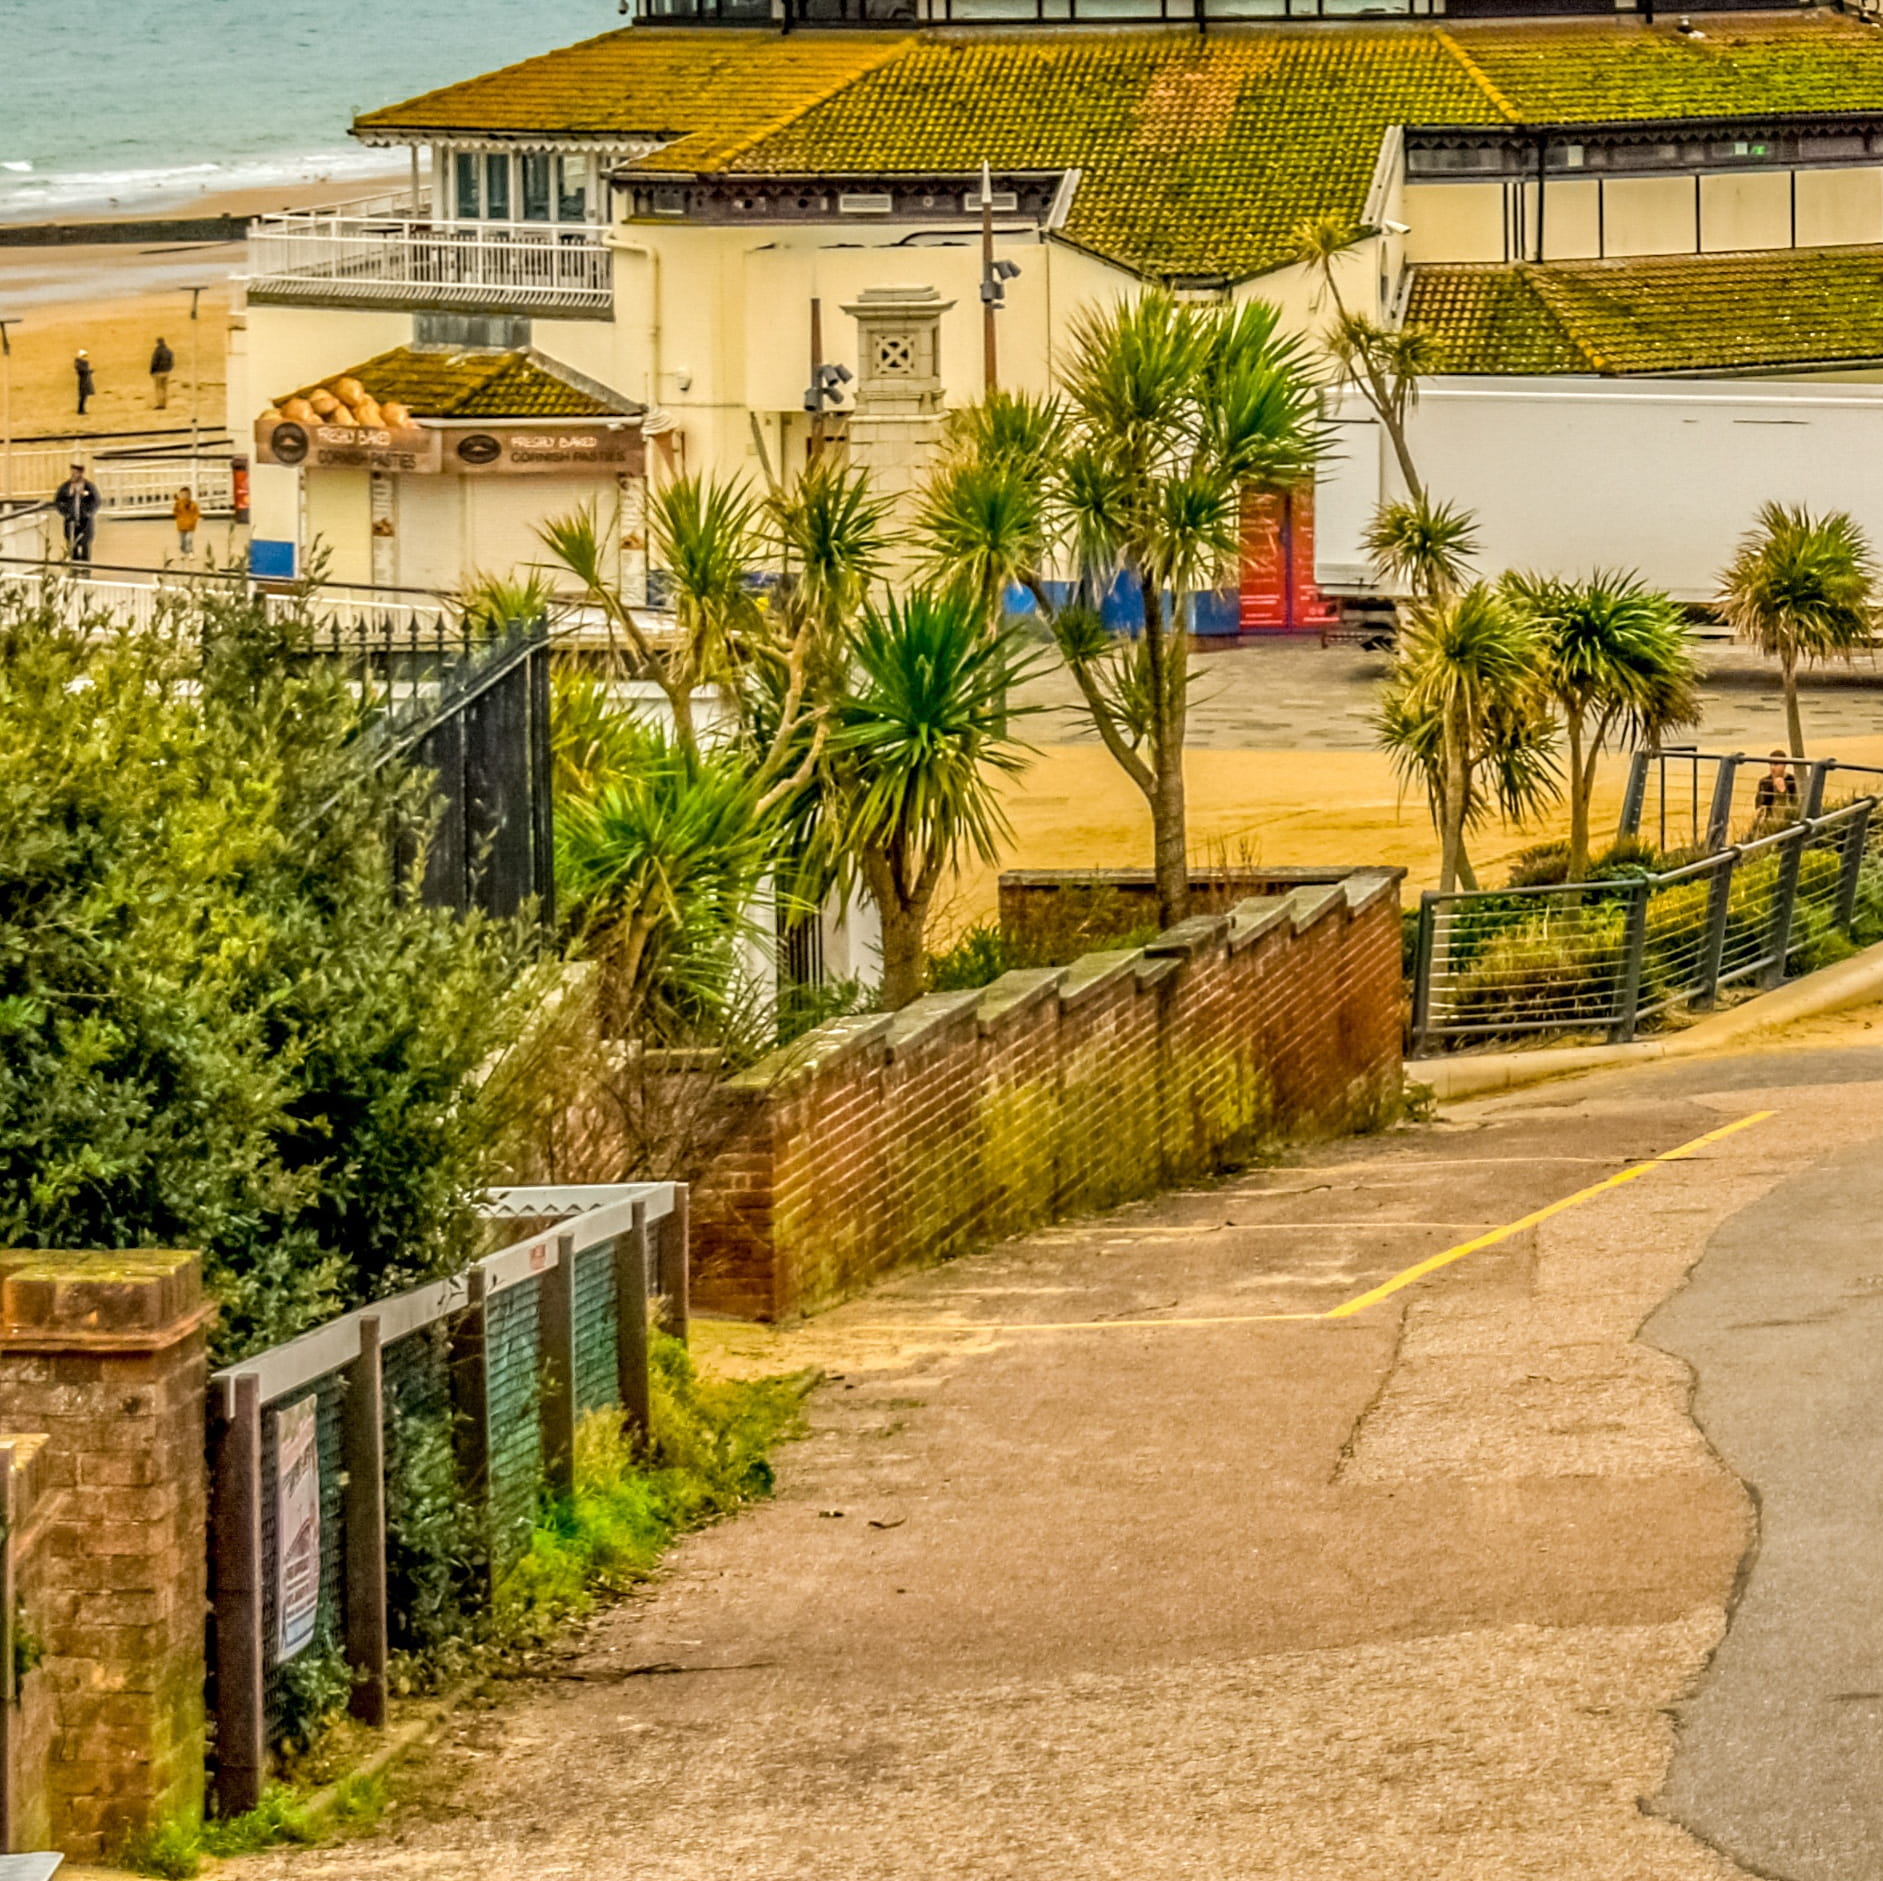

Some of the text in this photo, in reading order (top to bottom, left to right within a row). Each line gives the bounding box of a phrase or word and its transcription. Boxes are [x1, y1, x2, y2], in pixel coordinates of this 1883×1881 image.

[511, 436, 598, 448] FRESHLY BAKED
[369, 451, 416, 468] PASTIES
[511, 451, 627, 463] CORNISH PASTIES
